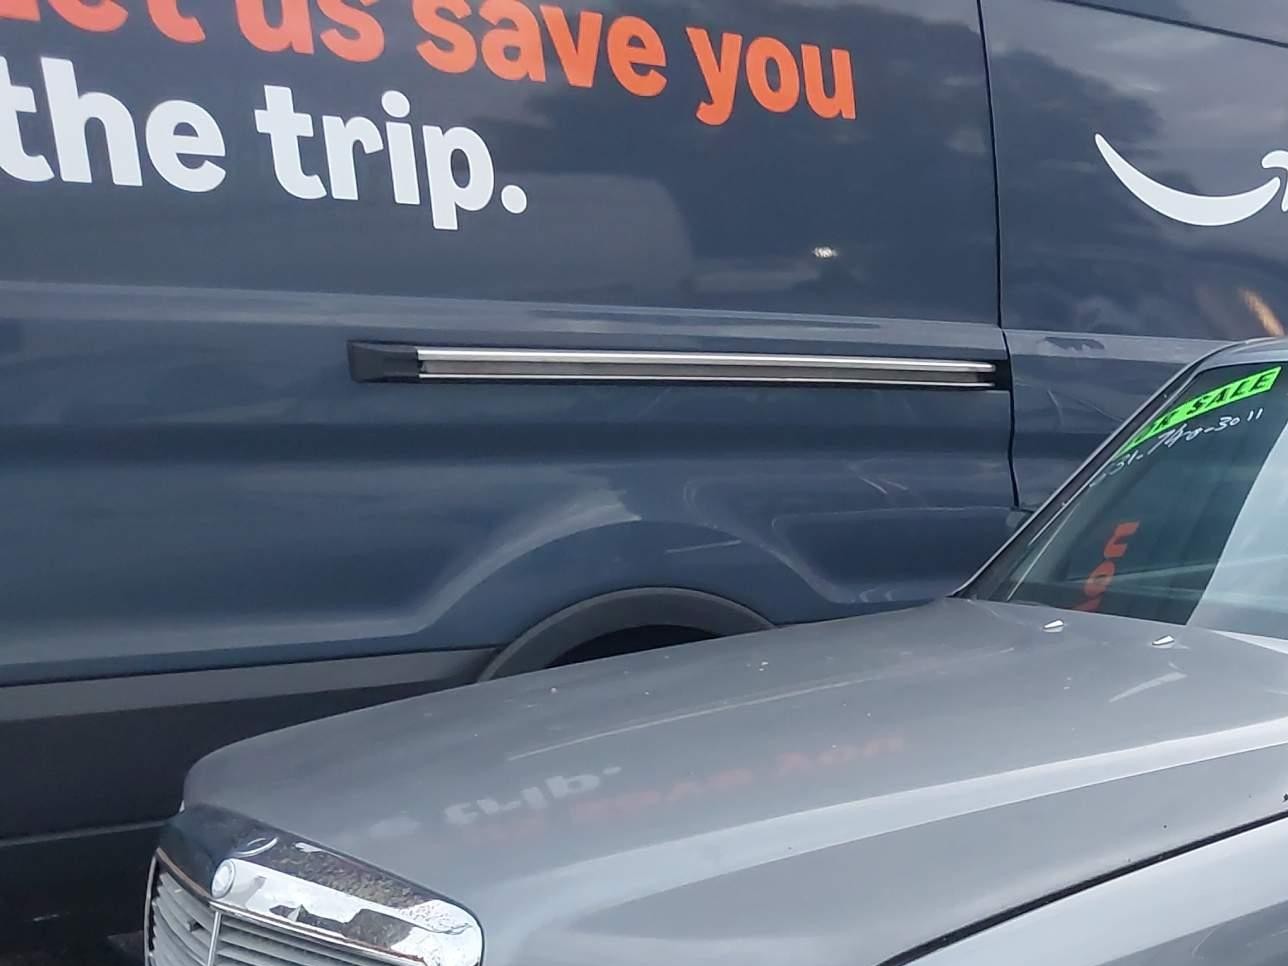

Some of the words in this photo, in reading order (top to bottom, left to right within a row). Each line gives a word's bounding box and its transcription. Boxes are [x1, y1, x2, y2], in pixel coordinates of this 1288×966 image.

[415, 0, 667, 97] save
[685, 26, 857, 126] you
[0, 55, 227, 192] the
[254, 84, 528, 231] trip.
